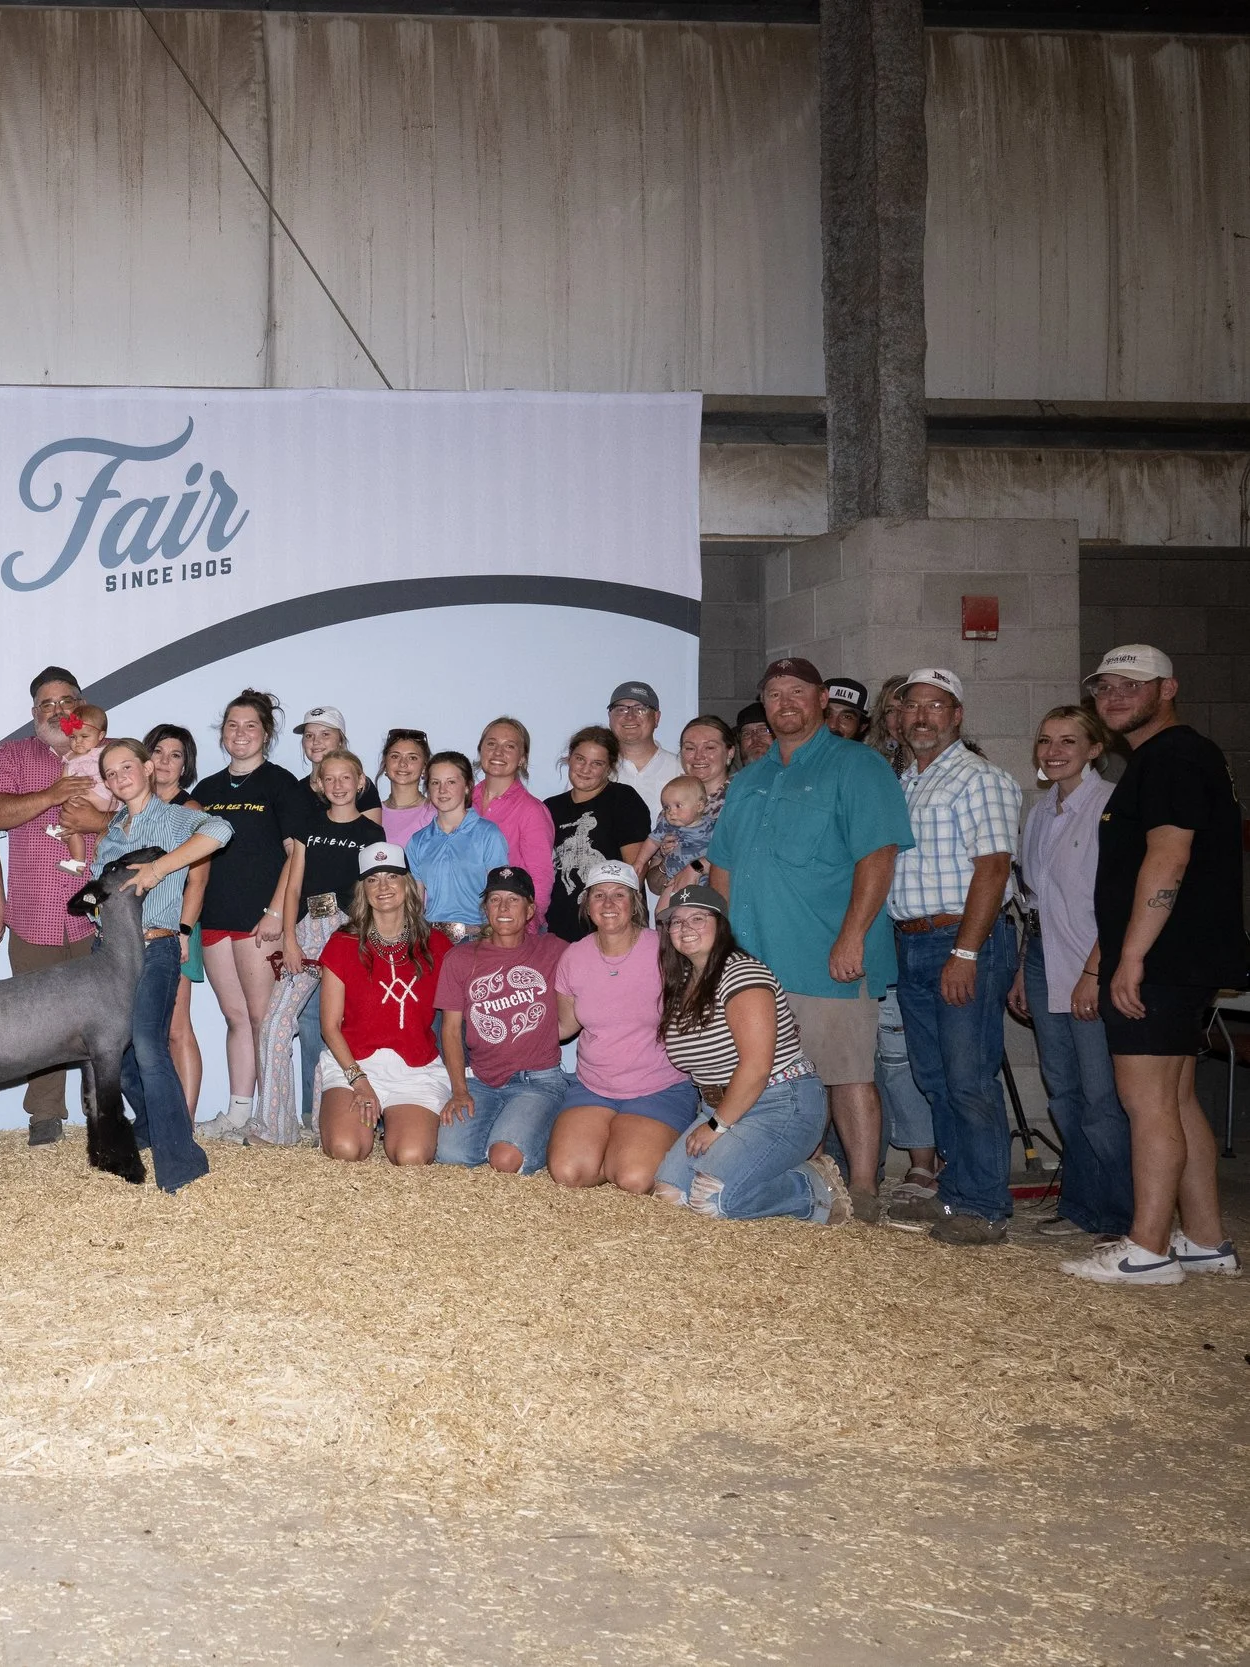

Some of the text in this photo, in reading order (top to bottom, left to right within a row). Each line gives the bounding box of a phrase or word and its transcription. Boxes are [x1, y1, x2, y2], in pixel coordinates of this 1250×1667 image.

[0, 415, 250, 592] Fair
[105, 557, 232, 592] SINCE 1905
[835, 688, 846, 698] ALL
[244, 803, 265, 812] TIME
[482, 987, 535, 1015] Punchy
